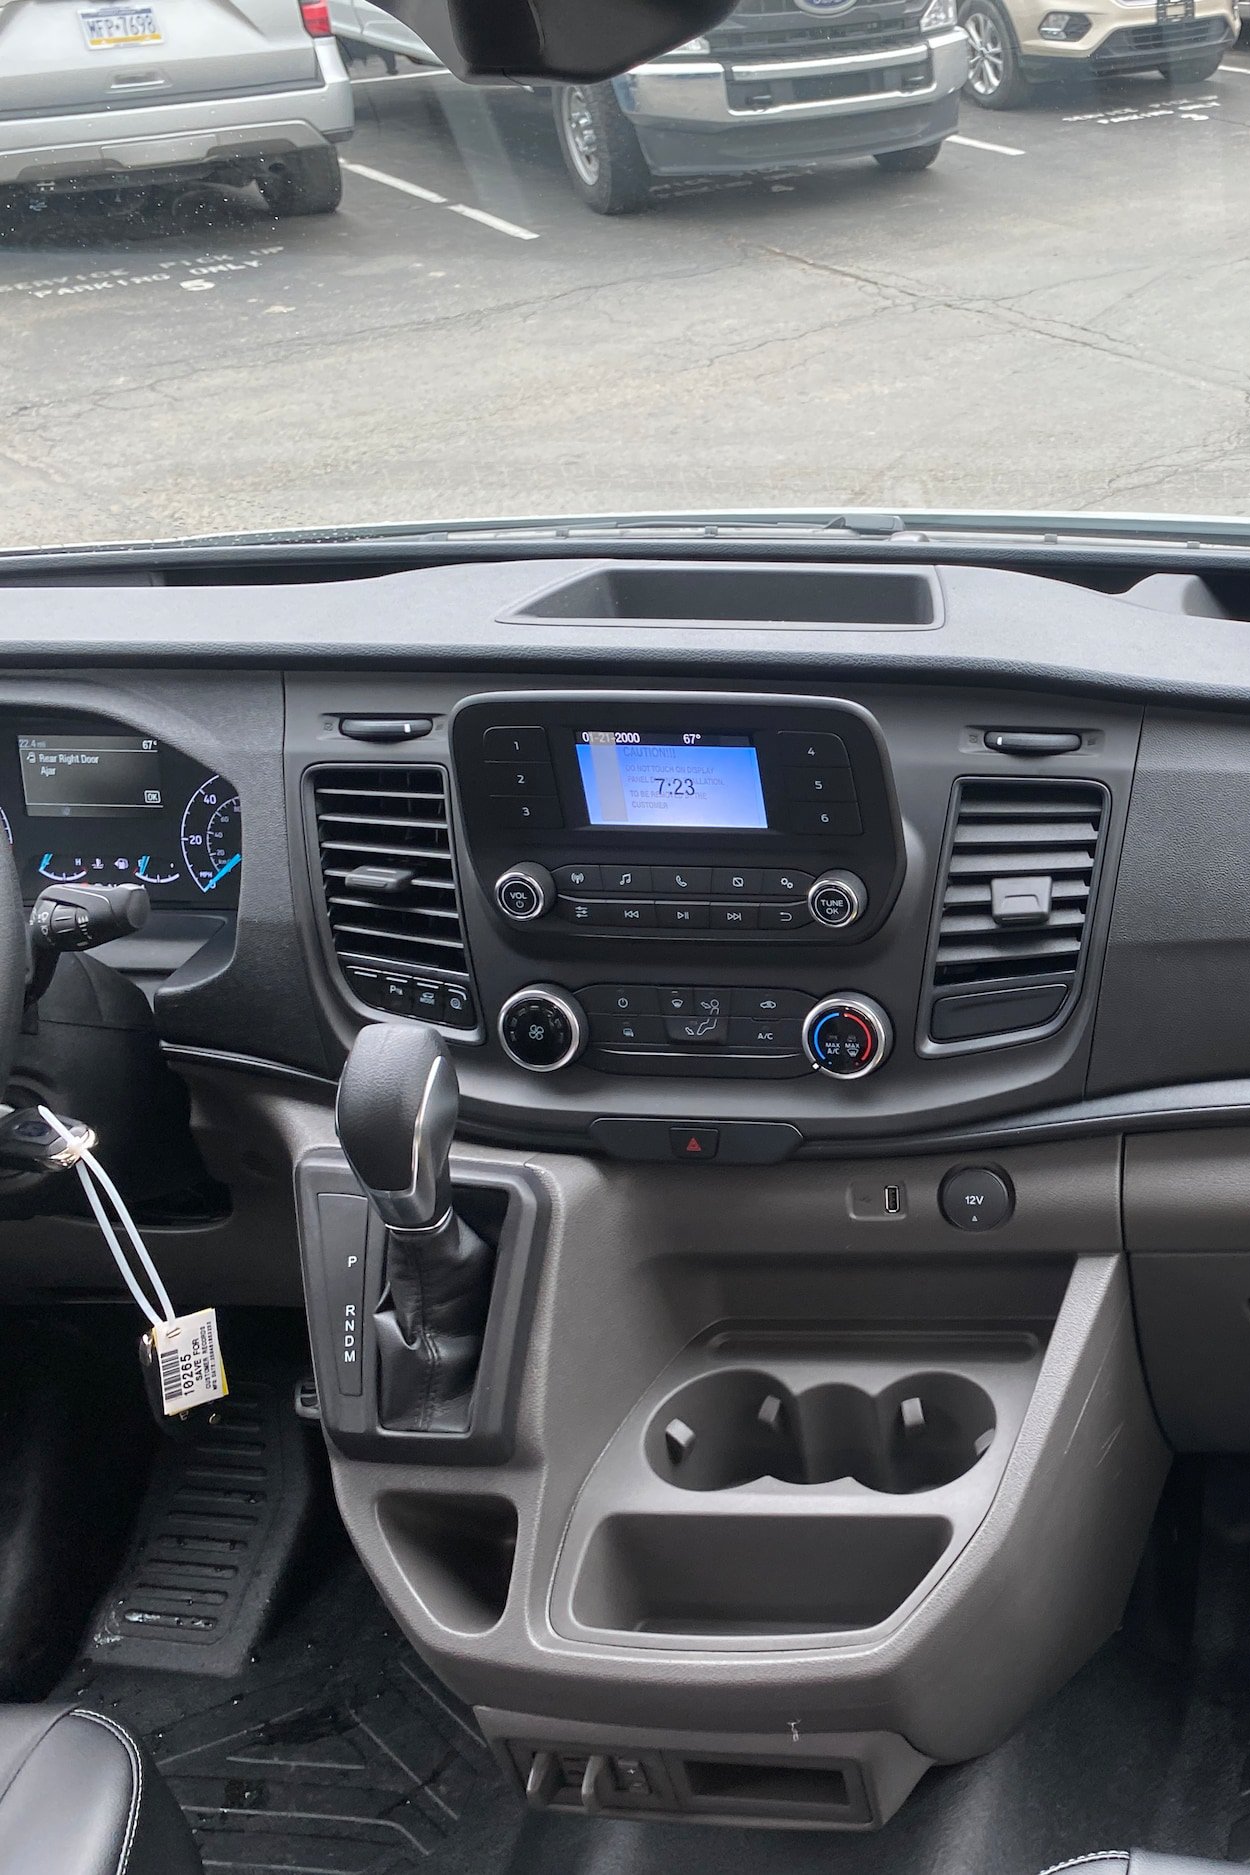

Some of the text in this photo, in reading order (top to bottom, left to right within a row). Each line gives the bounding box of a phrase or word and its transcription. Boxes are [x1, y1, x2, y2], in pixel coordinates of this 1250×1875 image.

[19, 739, 36, 747] 22.4
[582, 732, 641, 743] 01-21-2000
[683, 733, 701, 745] 67°
[514, 741, 520, 750] 1
[807, 747, 816, 756] 4
[39, 754, 99, 765] Rear Right Door
[40, 766, 56, 777] Ajar
[516, 774, 525, 784] 2
[654, 778, 695, 796] 7:23
[814, 781, 823, 790] 5
[203, 795, 217, 805] 40
[522, 806, 530, 816] 3
[820, 813, 829, 823] 6
[189, 835, 202, 845] 20
[510, 892, 527, 900] VOL
[820, 899, 844, 907] TUNE
[757, 1032, 773, 1040] A/C
[964, 1195, 984, 1205] 12V
[347, 1255, 358, 1268] P
[345, 1304, 356, 1317] R
[345, 1319, 355, 1332] N
[200, 1326, 208, 1354] RECORDS
[344, 1335, 355, 1347] D
[192, 1337, 203, 1381] SAVE FOR
[344, 1350, 356, 1362] M
[180, 1354, 195, 1397] 10265
[203, 1357, 211, 1390] CUSTOMER
